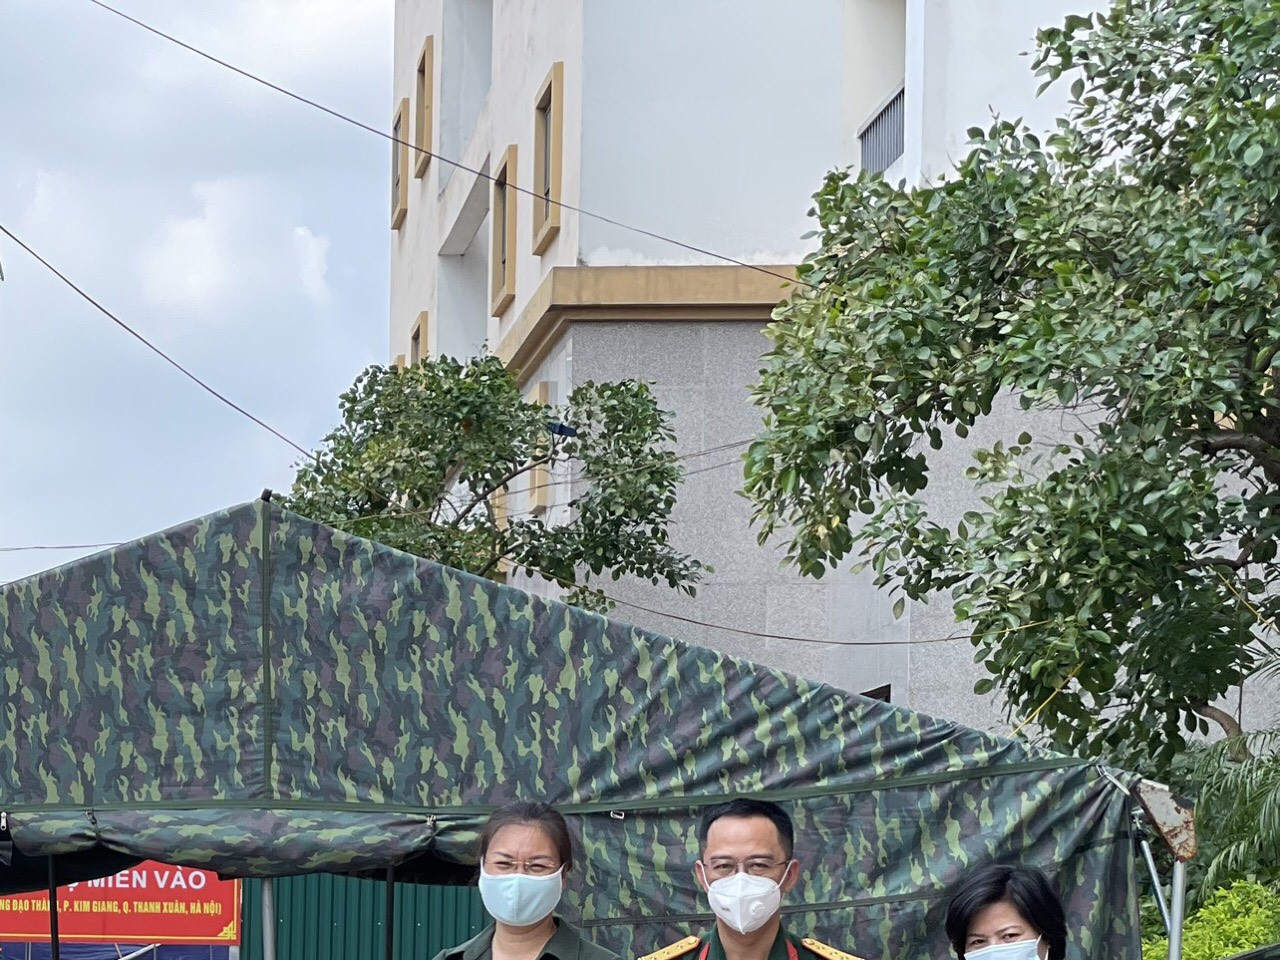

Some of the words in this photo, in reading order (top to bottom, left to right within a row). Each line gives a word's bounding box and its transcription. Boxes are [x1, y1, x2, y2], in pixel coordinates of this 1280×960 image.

[153, 865, 206, 889] VÀO
[63, 901, 72, 913] P.
[74, 901, 91, 913] KIM
[92, 901, 121, 915] GIANG,
[122, 902, 131, 914] Q.
[133, 902, 161, 914] THANH
[162, 901, 188, 915] XUÂN,
[190, 900, 202, 915] HÀ
[203, 901, 222, 916] NỘI)
